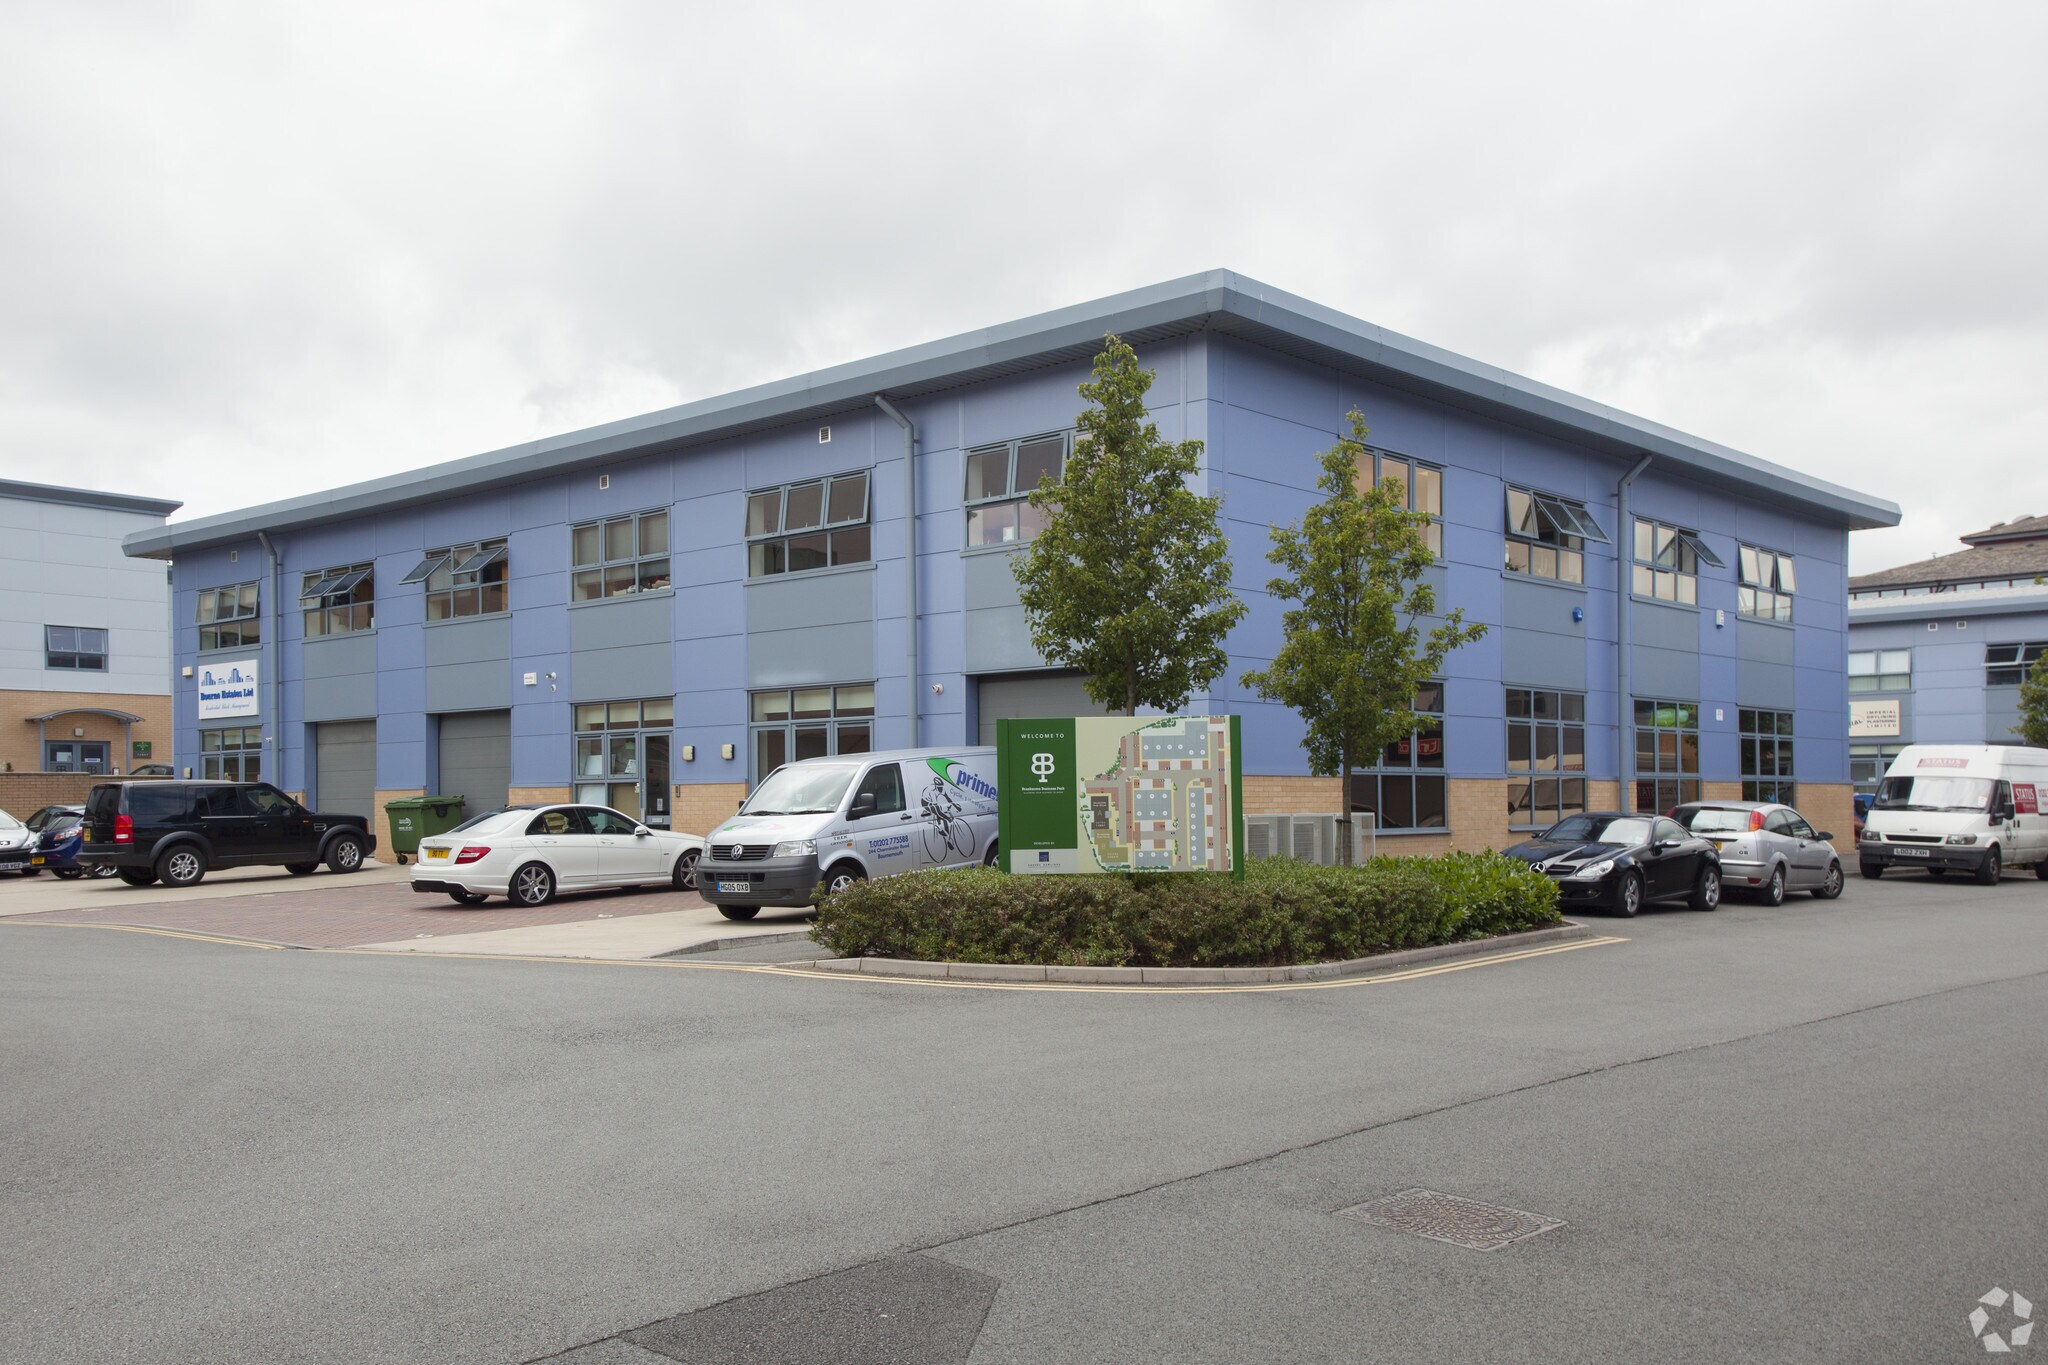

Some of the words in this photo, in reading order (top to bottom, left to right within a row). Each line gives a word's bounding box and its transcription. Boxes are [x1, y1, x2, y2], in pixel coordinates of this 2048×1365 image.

[221, 690, 242, 699] Estates
[243, 688, 254, 697] Ltd
[956, 769, 998, 801] prime
[2015, 787, 2035, 801] STATUS
[720, 883, 736, 892] HG05
[737, 883, 749, 892] OXB
